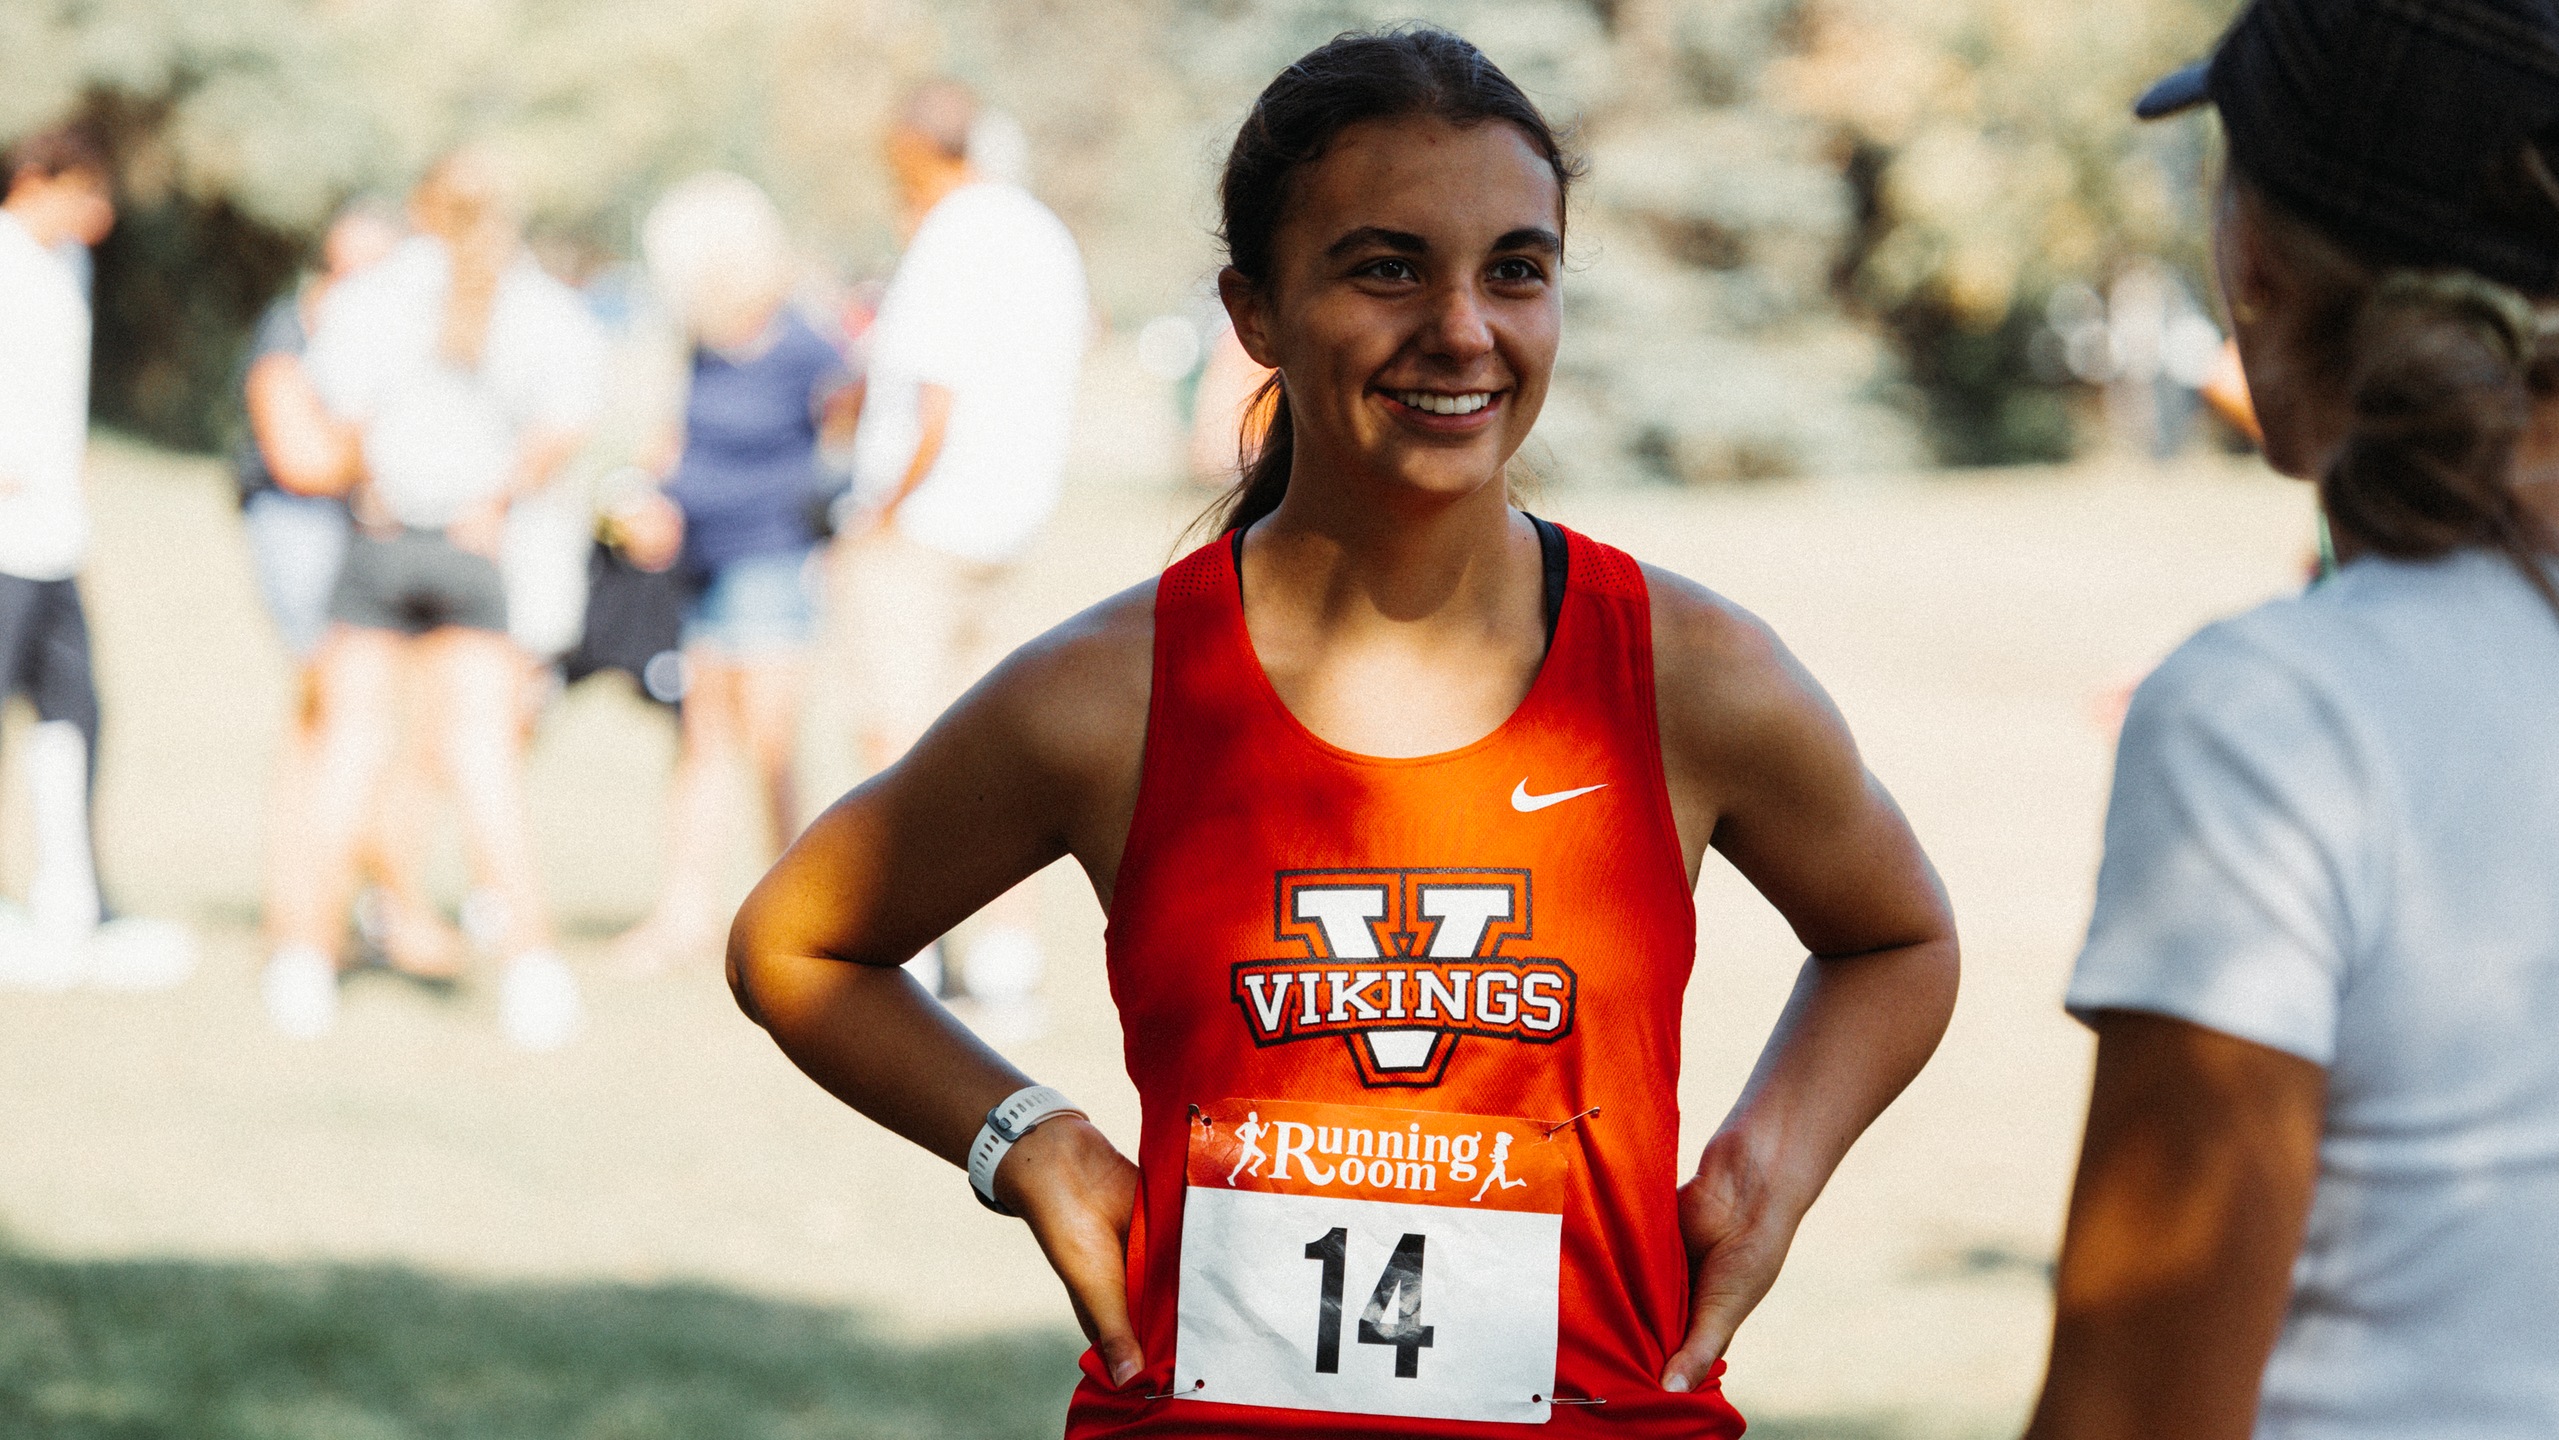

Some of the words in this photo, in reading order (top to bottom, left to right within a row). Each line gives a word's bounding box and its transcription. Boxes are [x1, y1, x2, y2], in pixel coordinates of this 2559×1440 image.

[1243, 970, 1563, 1032] VIKINGS
[1268, 1120, 1482, 1187] Running
[1304, 1226, 1435, 1379] 14
